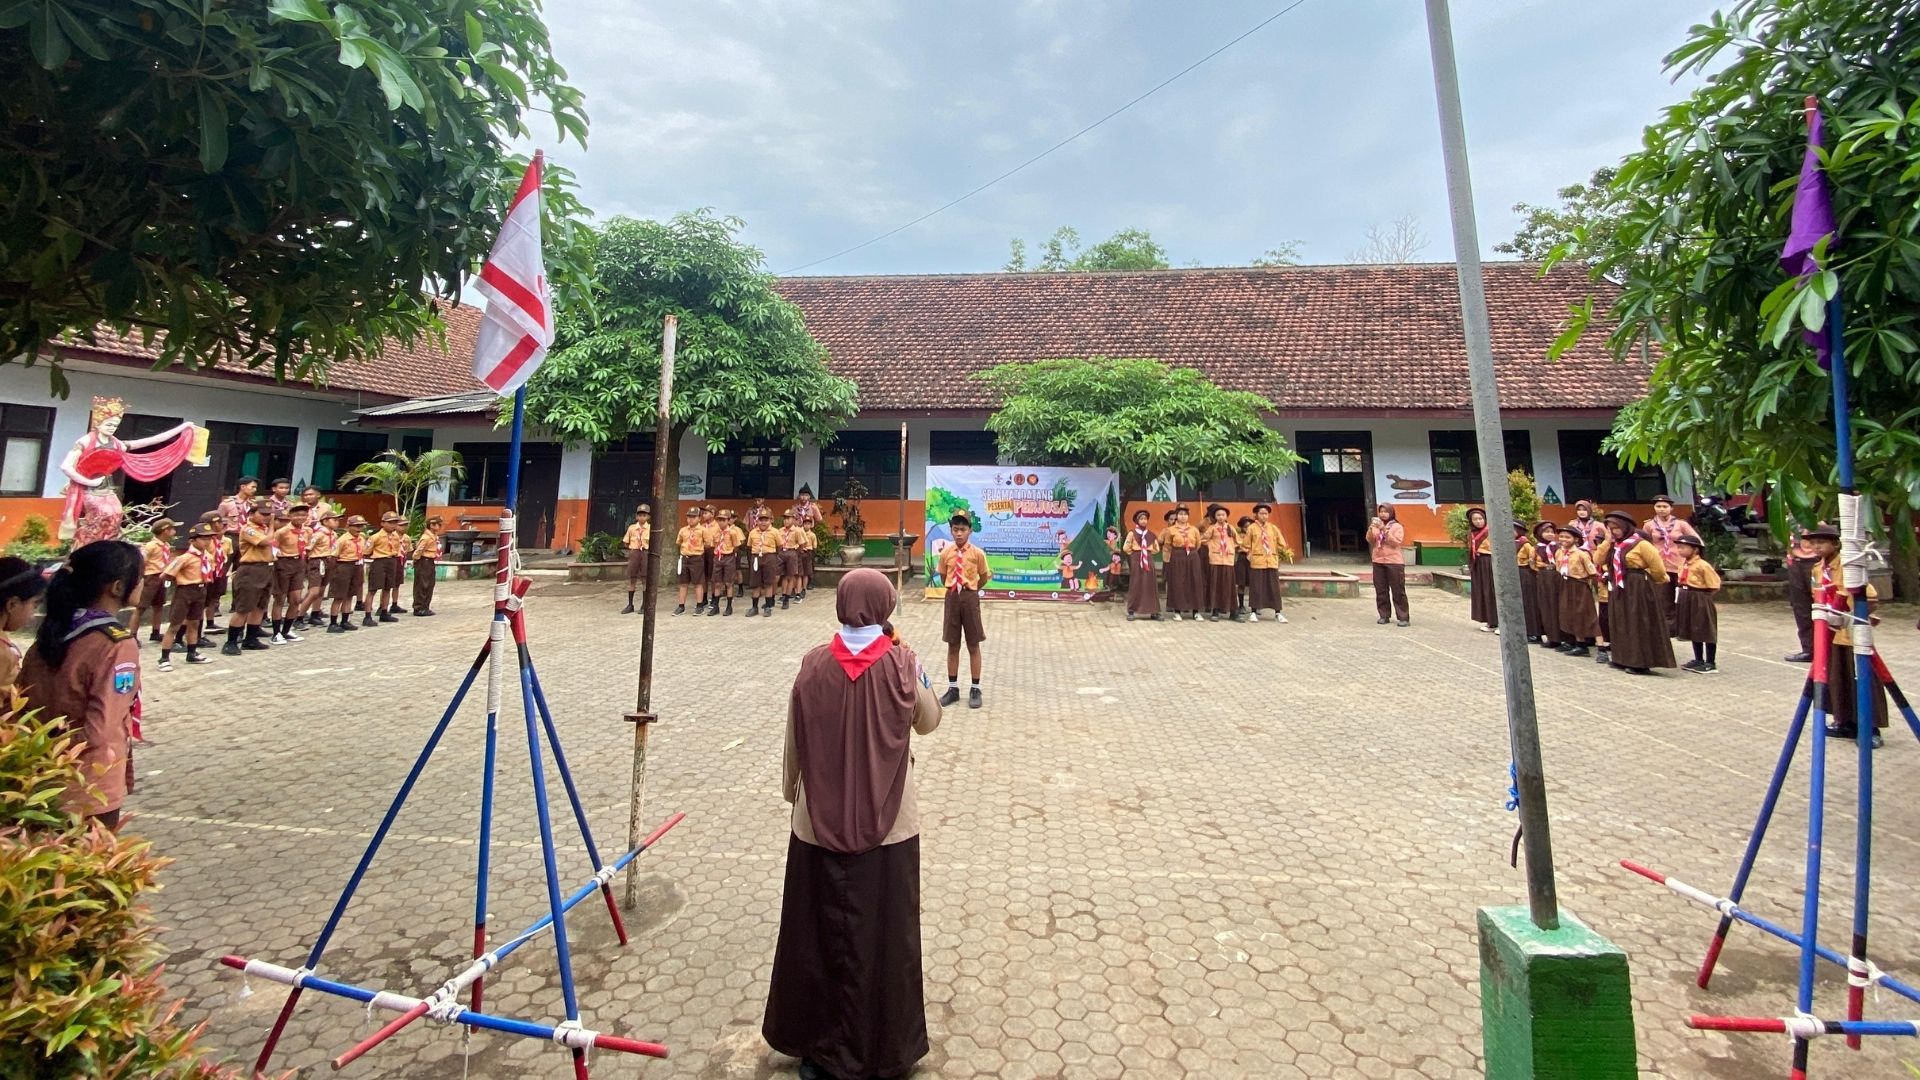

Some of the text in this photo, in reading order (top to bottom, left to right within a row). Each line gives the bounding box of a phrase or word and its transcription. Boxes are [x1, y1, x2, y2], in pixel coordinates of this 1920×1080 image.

[982, 488, 1053, 501] SELAMAT DATANG
[987, 500, 1069, 516] PESERTA PERJUSA
